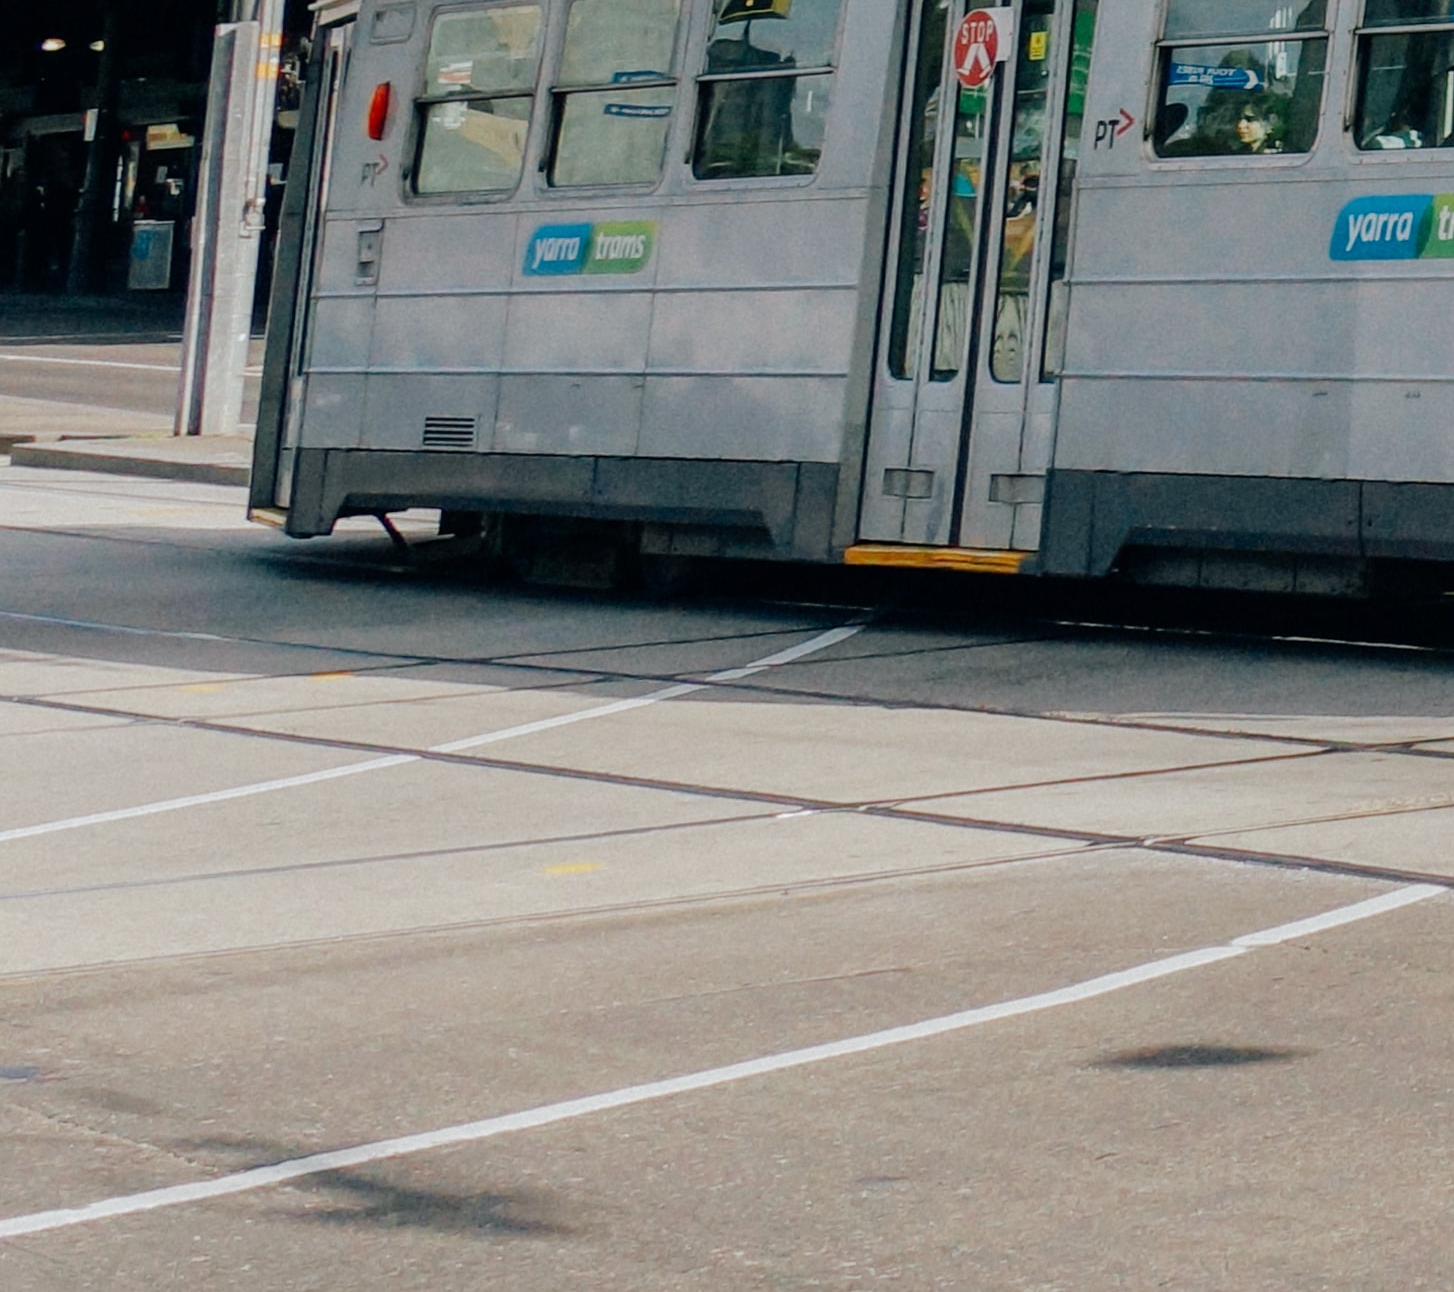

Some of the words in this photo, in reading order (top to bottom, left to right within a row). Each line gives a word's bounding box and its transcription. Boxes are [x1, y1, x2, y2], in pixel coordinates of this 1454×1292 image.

[961, 21, 994, 45] STOP
[1094, 119, 1120, 150] PT
[1345, 212, 1413, 252] yarra
[532, 234, 580, 269] yarra
[595, 231, 645, 261] trams
